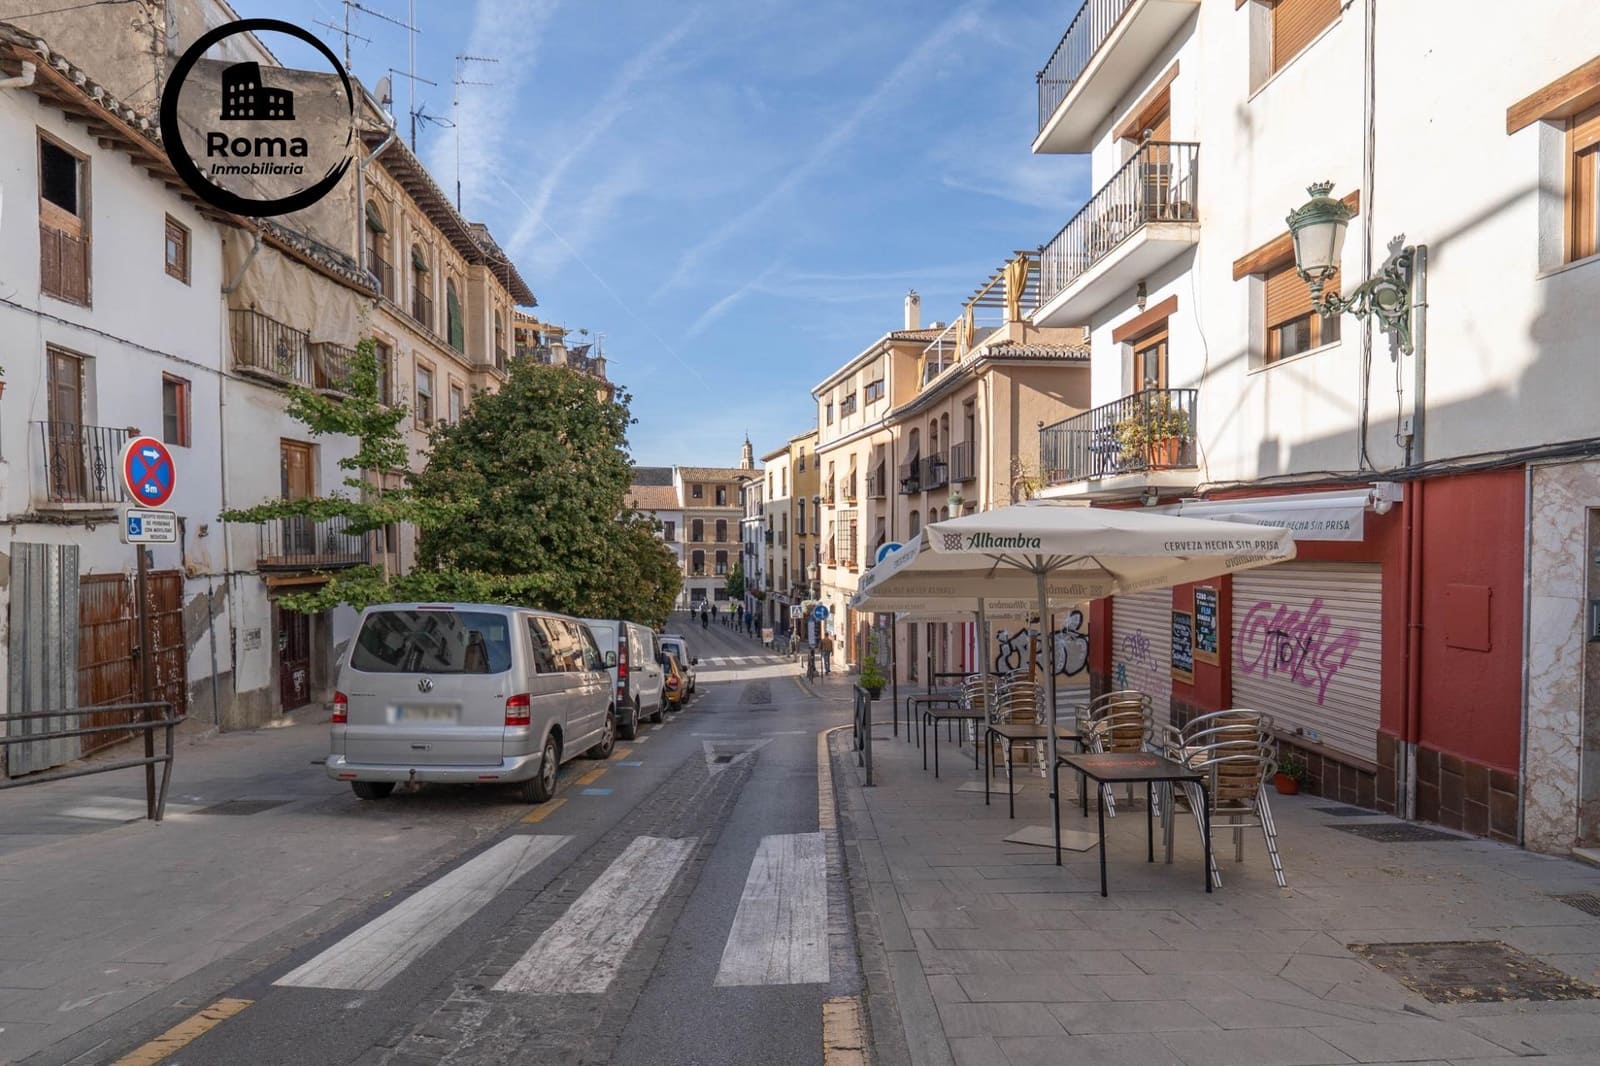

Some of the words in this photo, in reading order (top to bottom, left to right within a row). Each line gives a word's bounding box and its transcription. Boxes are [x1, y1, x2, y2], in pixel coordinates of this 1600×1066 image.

[144, 483, 158, 494] 5m
[1287, 520, 1310, 530] HECHA
[1312, 520, 1323, 530] SIN
[1325, 520, 1350, 531] PRISA
[966, 532, 1041, 549] Alhambra
[1164, 541, 1203, 552] CERVEZA
[1204, 541, 1235, 551] HECHA
[1236, 540, 1251, 550] SIN
[1255, 541, 1279, 550] PRISA
